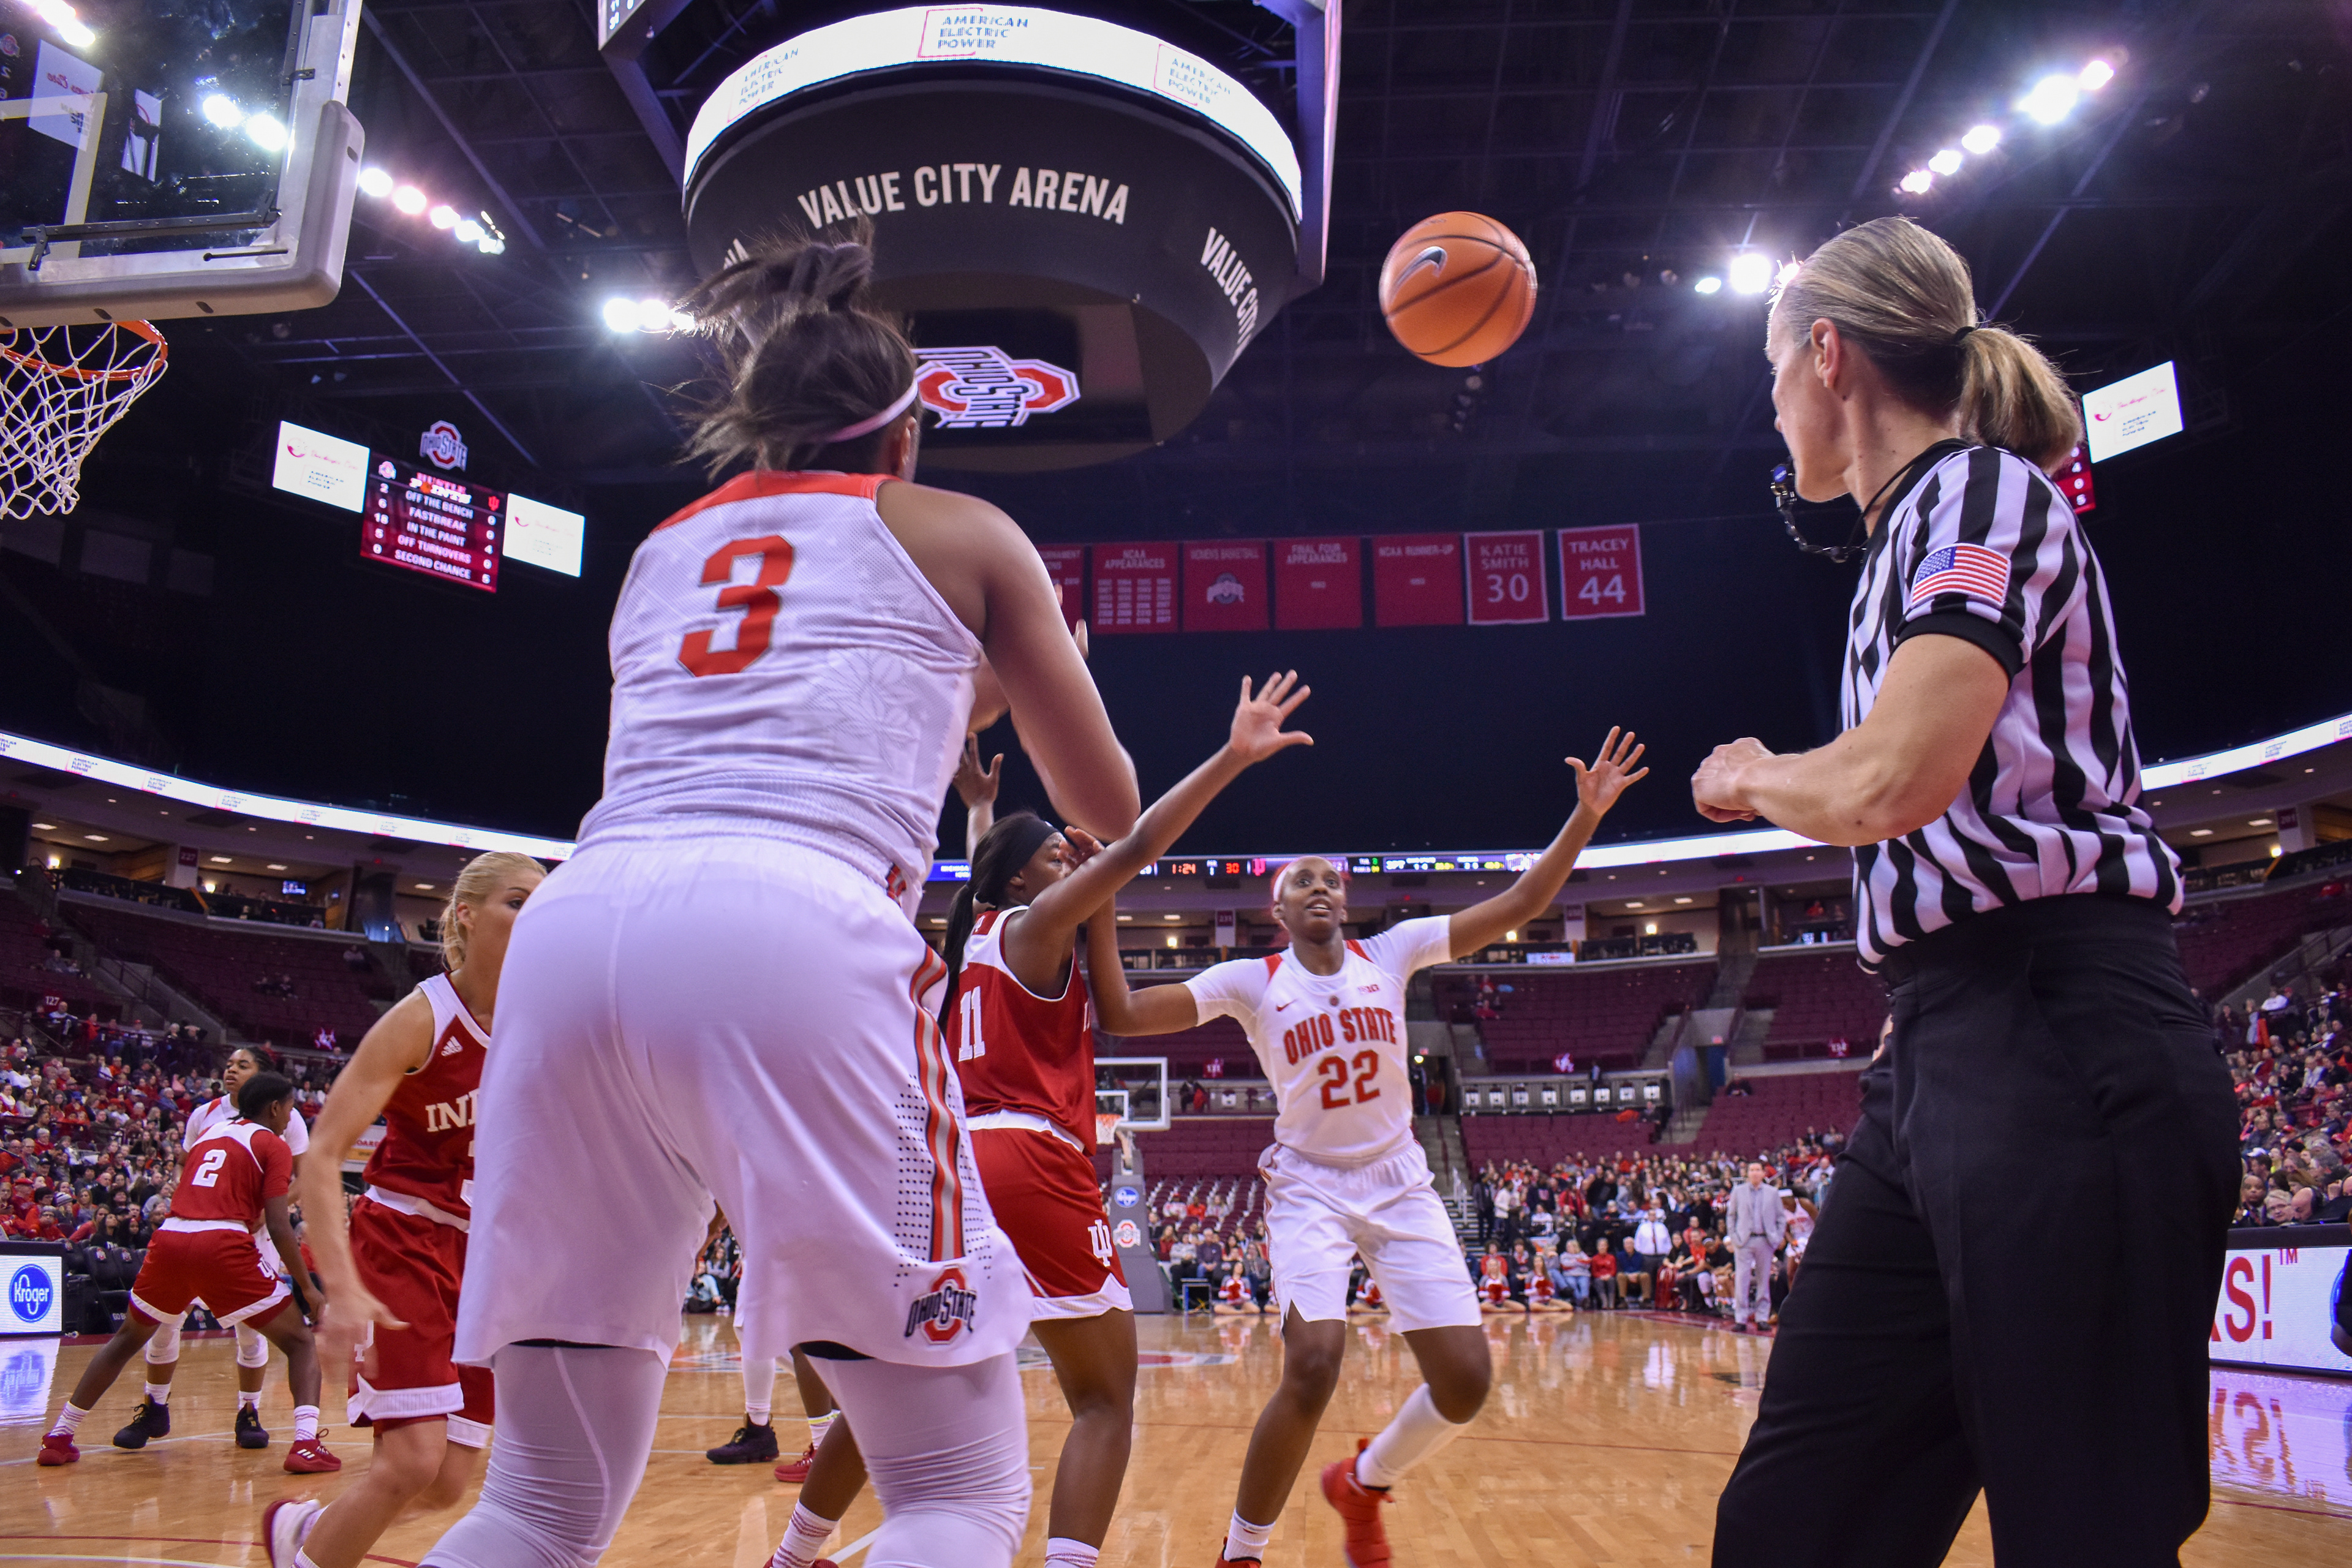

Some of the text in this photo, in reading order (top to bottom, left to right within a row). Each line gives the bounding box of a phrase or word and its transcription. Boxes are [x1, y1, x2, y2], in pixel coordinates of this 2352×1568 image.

[940, 26, 1011, 38] ELECTRIC
[941, 15, 1028, 28] AMERICAN
[937, 37, 997, 50] POWER
[797, 164, 1129, 230] VALUE CITY ARENA
[1200, 226, 1253, 307] VALUE
[379, 483, 390, 494] 2
[405, 490, 474, 519] OFF THE BENCH
[374, 512, 390, 525] 18
[409, 507, 467, 533] FASTBREAK
[407, 521, 466, 547] IN THE PAINT
[1568, 538, 1629, 554] TRACEY
[398, 534, 472, 565] OFF TURNOVERS
[484, 544, 494, 555] 4
[1480, 543, 1527, 556] KATIE
[394, 549, 472, 579] SECOND CHANCE
[1481, 557, 1529, 570] SMITH
[1580, 557, 1619, 571] HALL
[1486, 573, 1530, 603] 30
[1578, 573, 1627, 605] 44
[676, 534, 795, 678] 3
[1172, 863, 1196, 875] 1:24
[1226, 862, 1240, 874] 30
[45, 996, 60, 1006] 127
[958, 985, 986, 1063] 11
[1283, 1006, 1397, 1066] OHIO STATE
[1317, 1049, 1381, 1110] 22
[191, 1148, 227, 1188] 2
[13, 1273, 50, 1316] Kroger
[904, 1286, 977, 1338] OHIO STATE
